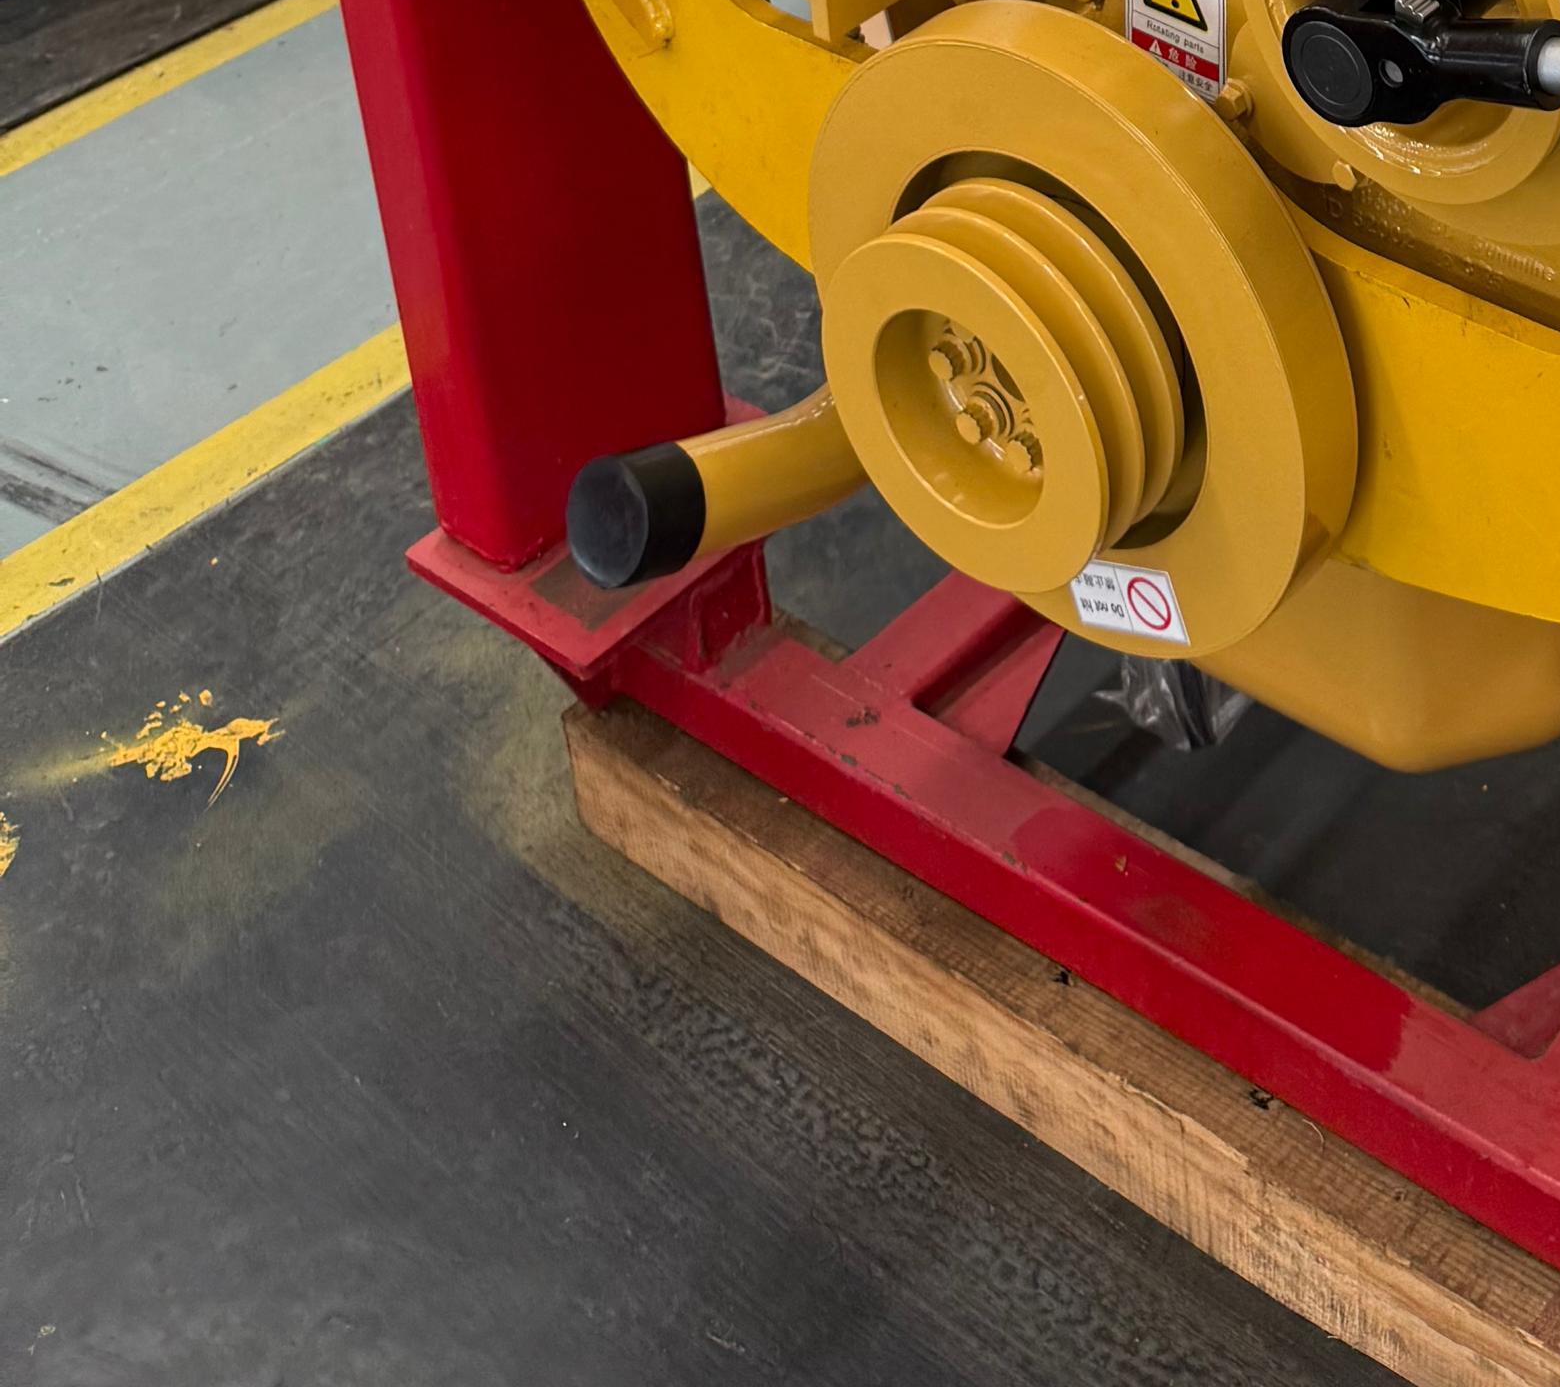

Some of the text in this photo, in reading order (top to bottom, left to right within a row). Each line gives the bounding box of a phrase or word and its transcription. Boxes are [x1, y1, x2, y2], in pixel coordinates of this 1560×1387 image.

[1146, 19, 1205, 55] Rotating parts
[1168, 46, 1197, 71] 危险
[1080, 597, 1125, 618] Do not hit
